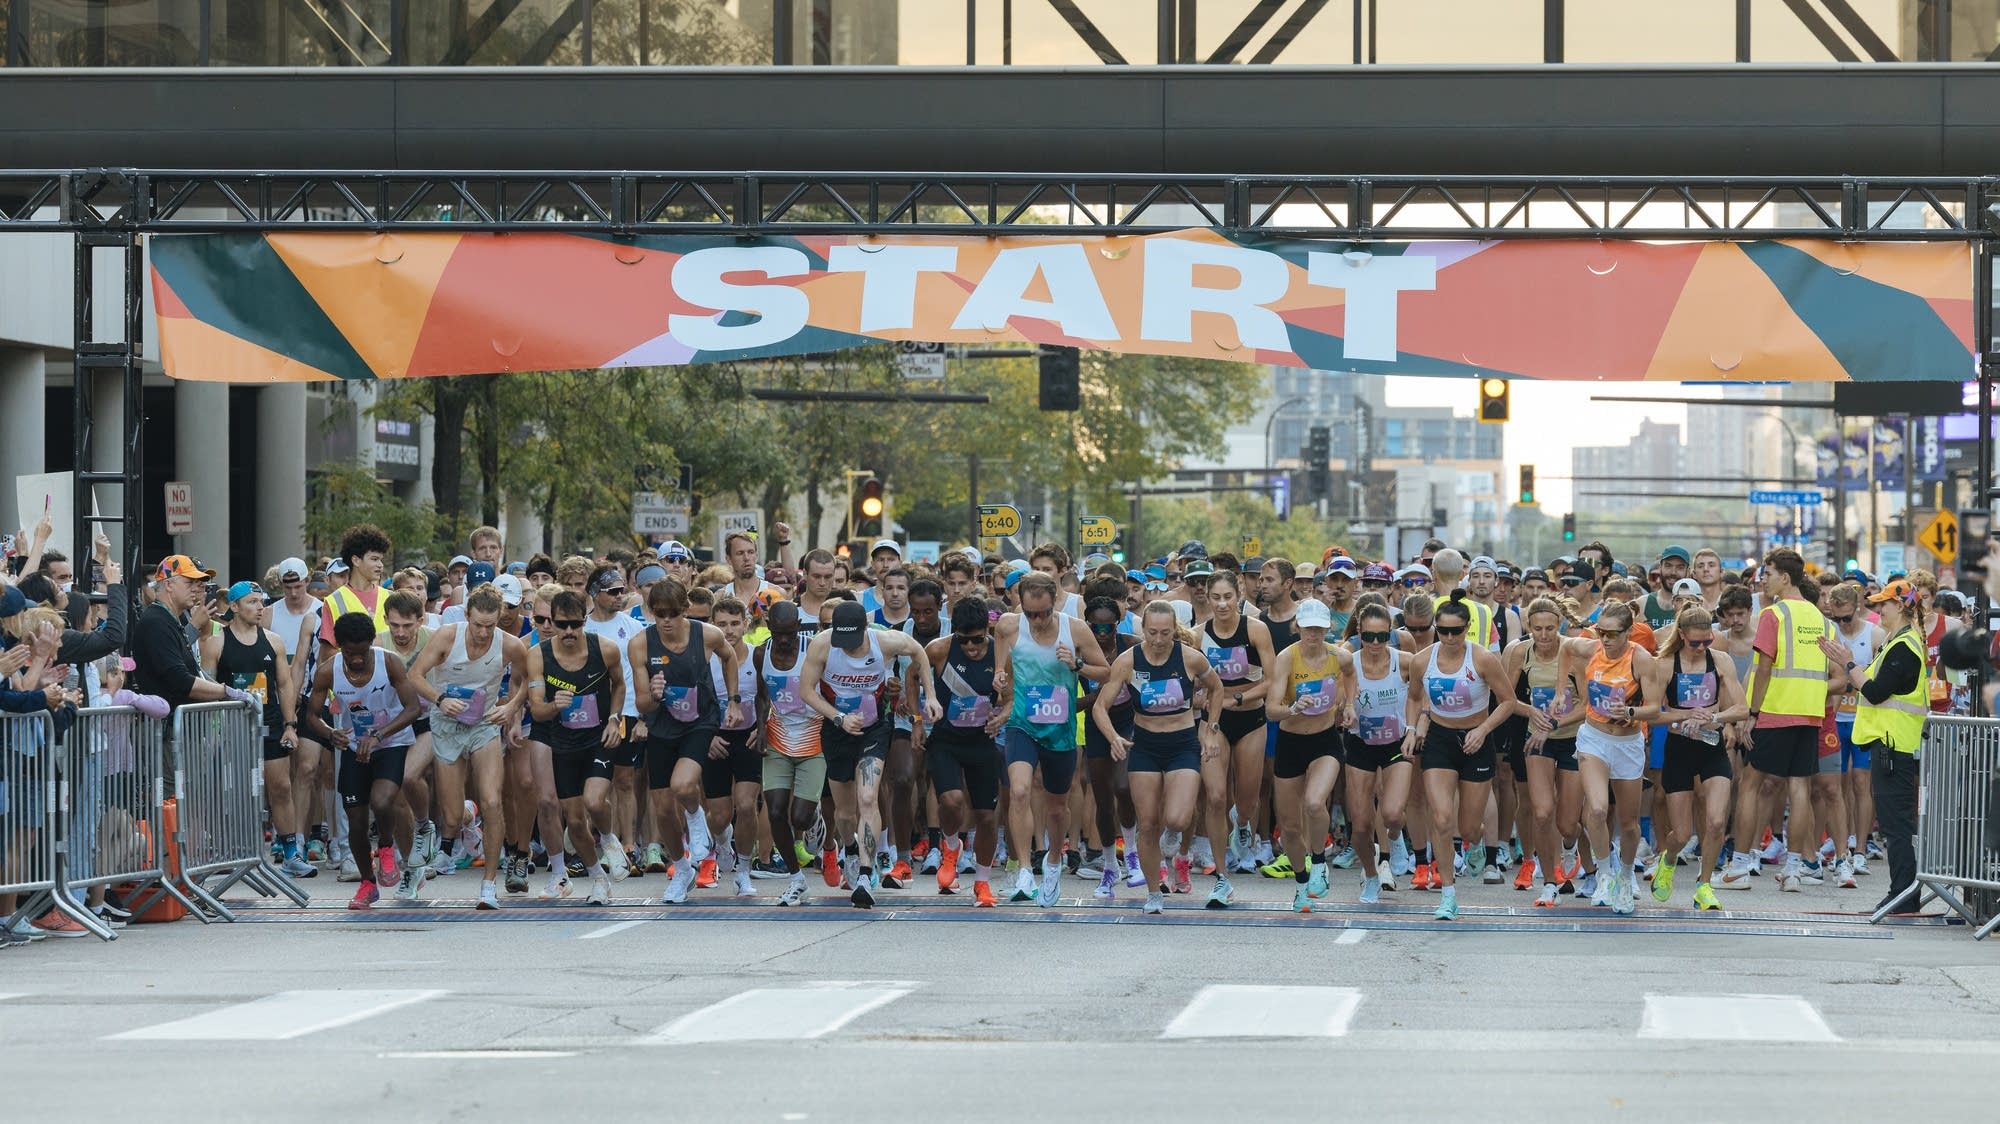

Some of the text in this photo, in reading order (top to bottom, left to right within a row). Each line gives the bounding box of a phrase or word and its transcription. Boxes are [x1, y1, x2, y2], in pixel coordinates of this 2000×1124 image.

[669, 237, 1436, 362] START
[172, 490, 186, 502] NO
[168, 506, 192, 515] PARKING
[645, 516, 678, 528] ENDS
[725, 518, 751, 529] END
[986, 517, 1014, 528] 6:40
[1087, 527, 1108, 538] 6:51
[1652, 619, 1660, 627] EL
[1214, 663, 1242, 675] 110
[832, 674, 880, 683] FITNESS
[776, 691, 794, 703] 25
[1377, 688, 1398, 698] IMARA
[1684, 689, 1711, 701] 116
[672, 701, 690, 711] 50
[1437, 696, 1465, 706] 105
[1032, 703, 1062, 717] 100
[569, 711, 589, 723] 23
[960, 711, 976, 721] 11
[1366, 729, 1393, 740] 115
